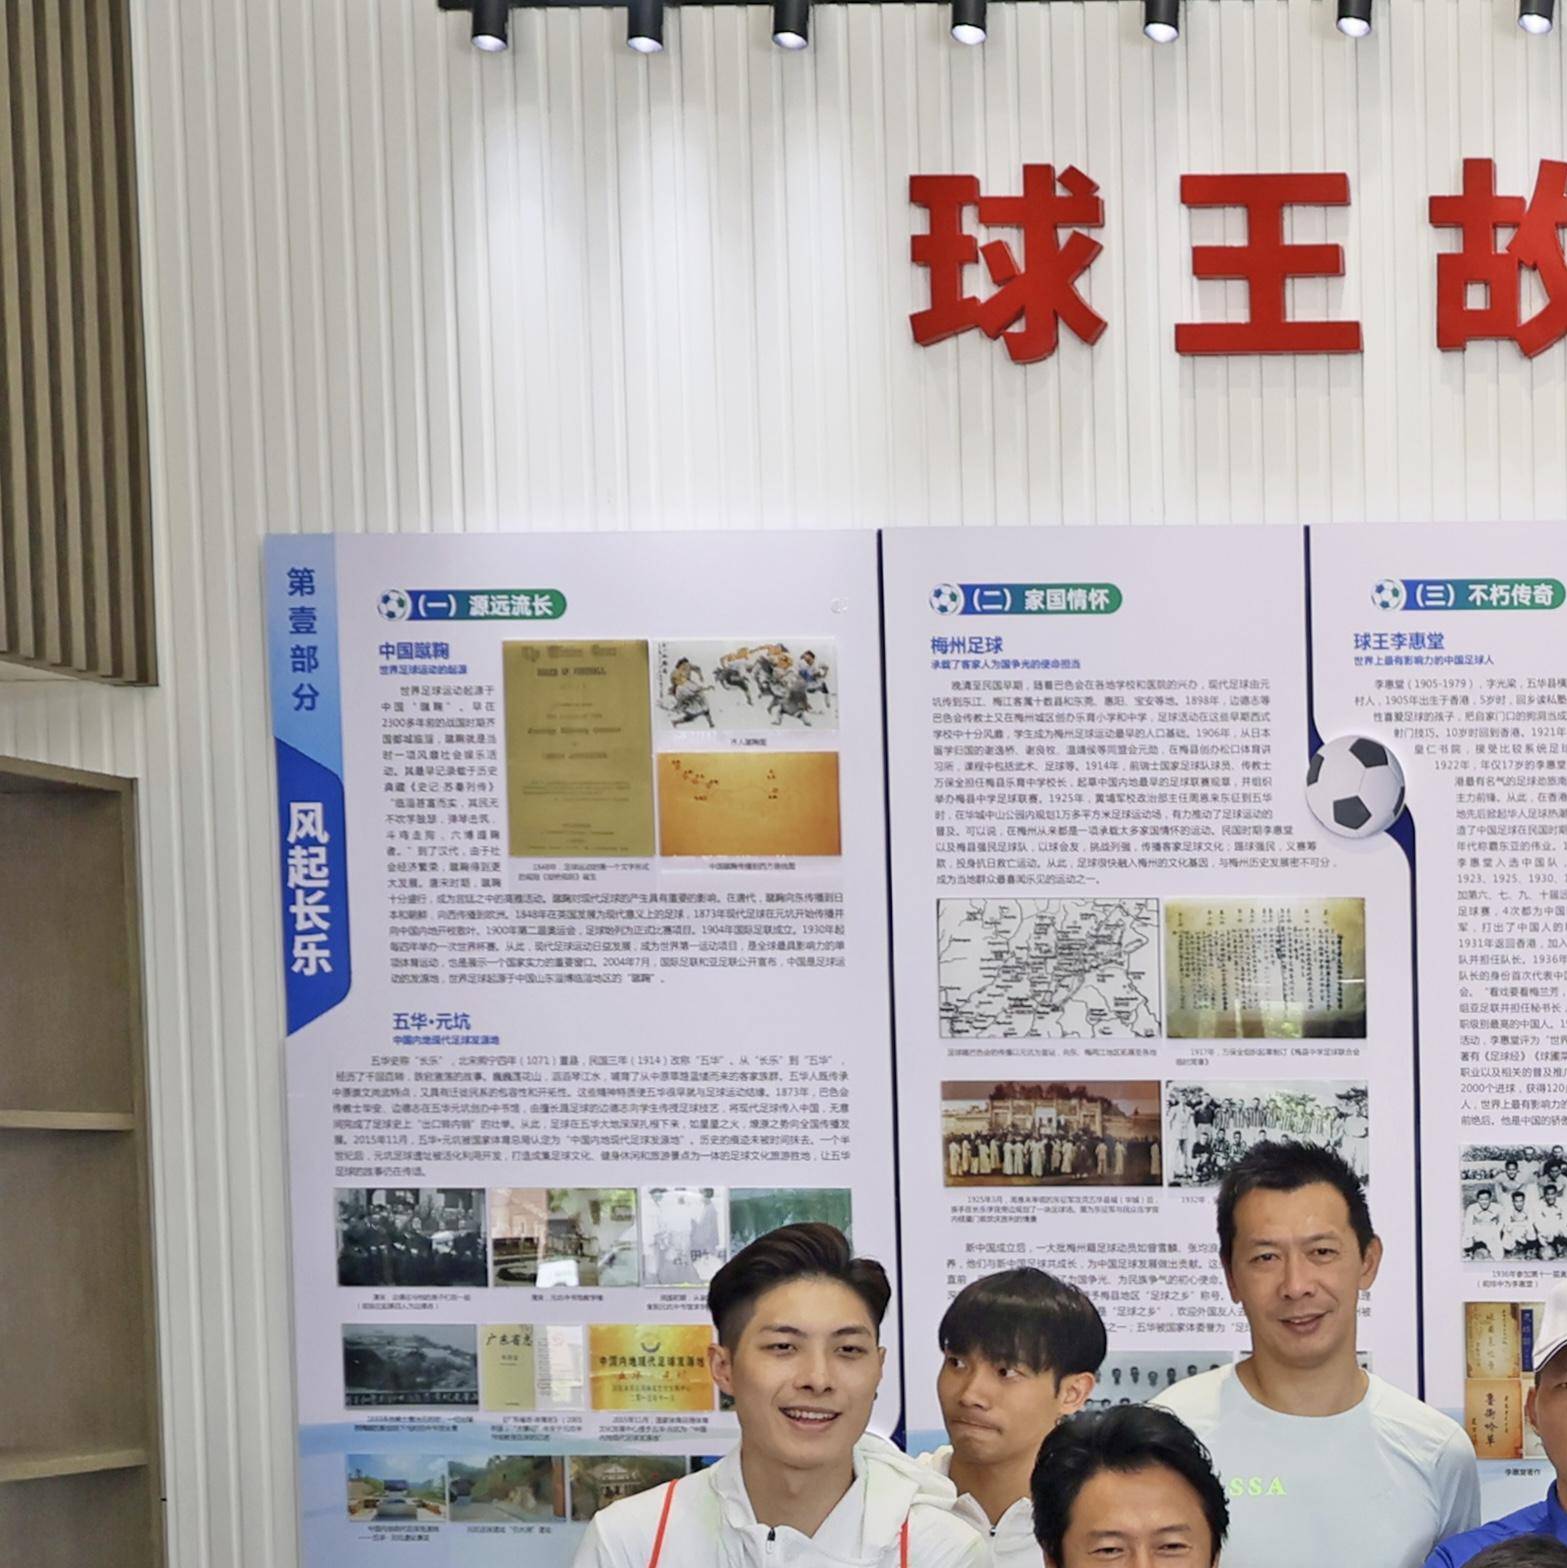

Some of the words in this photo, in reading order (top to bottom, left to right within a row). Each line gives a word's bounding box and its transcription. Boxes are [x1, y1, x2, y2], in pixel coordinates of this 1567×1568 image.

[286, 567, 321, 713] 第壹部分
[930, 635, 1004, 655] 梅州足球
[1353, 631, 1445, 651] 球王李惠堂
[378, 640, 450, 661] 中国蹴鞠
[286, 801, 333, 976] 风起长乐
[1228, 1476, 1287, 1496] SSA
